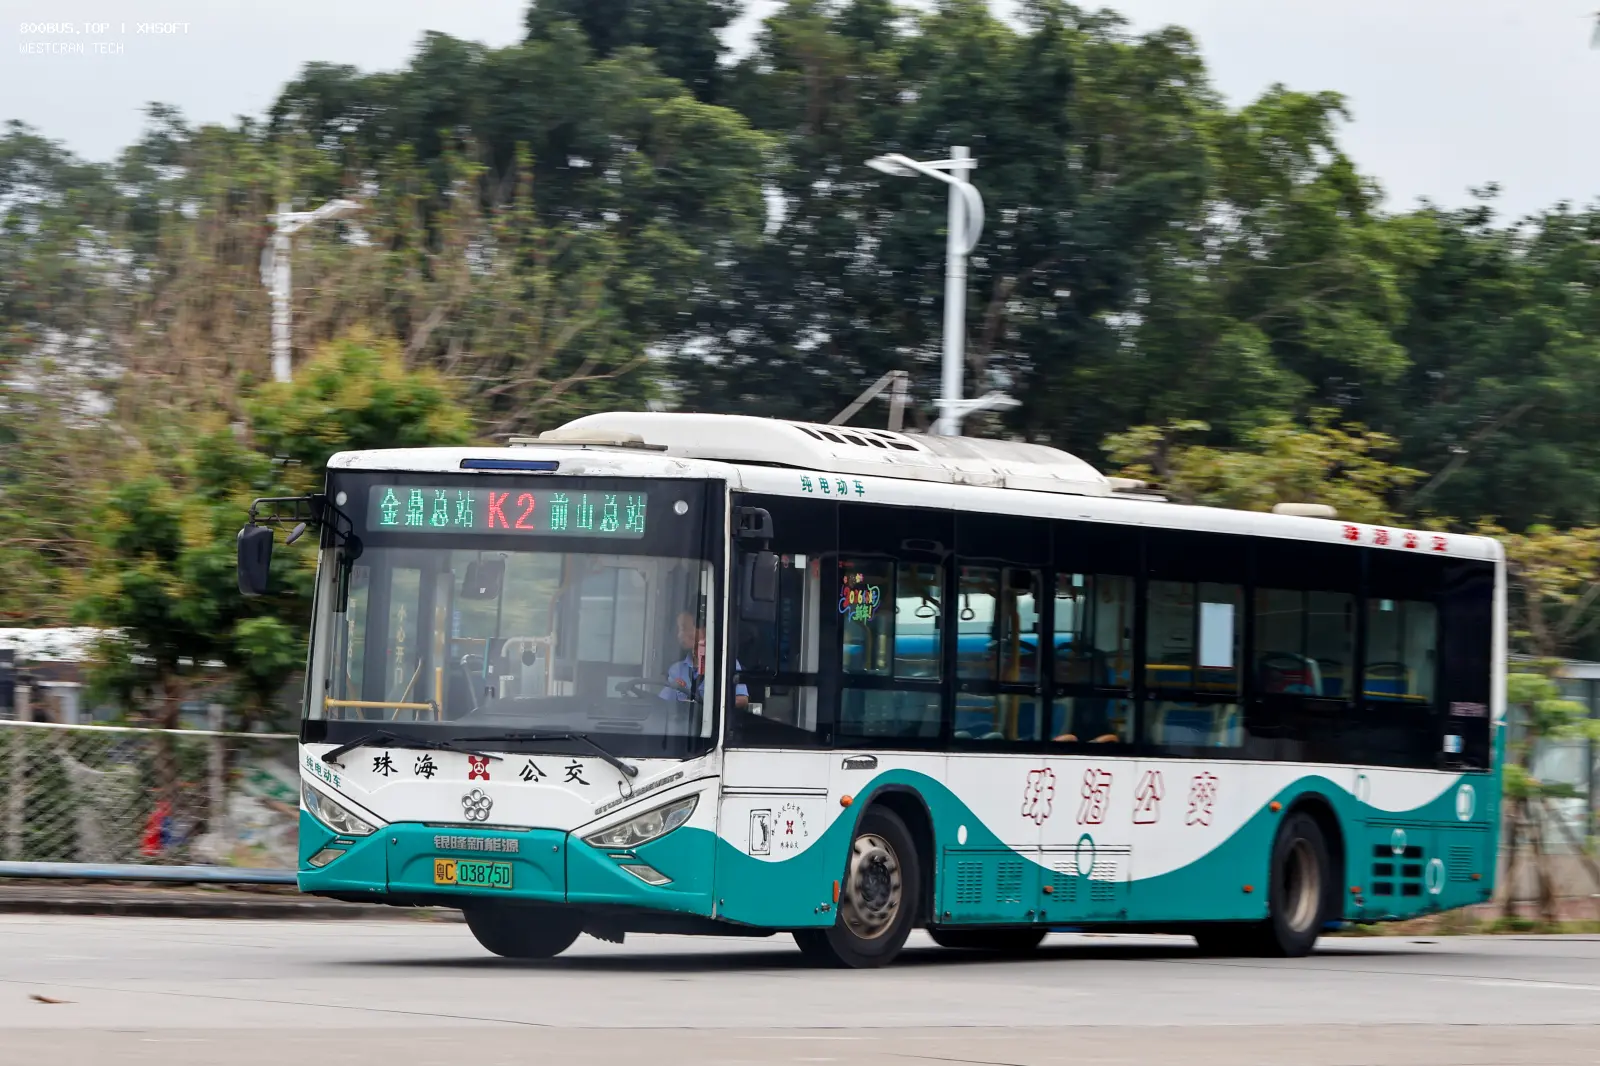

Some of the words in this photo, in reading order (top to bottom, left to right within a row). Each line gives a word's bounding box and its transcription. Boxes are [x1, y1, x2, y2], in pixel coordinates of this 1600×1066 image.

[800, 474, 866, 498] 纯电动车
[379, 488, 475, 529] 金鼎总站
[487, 491, 537, 531] K2
[549, 492, 646, 533] 前山总站
[306, 755, 342, 789] 纯电动车
[372, 751, 439, 780] 珠海
[518, 758, 591, 786] 公交
[433, 834, 519, 853] 银隆新能源
